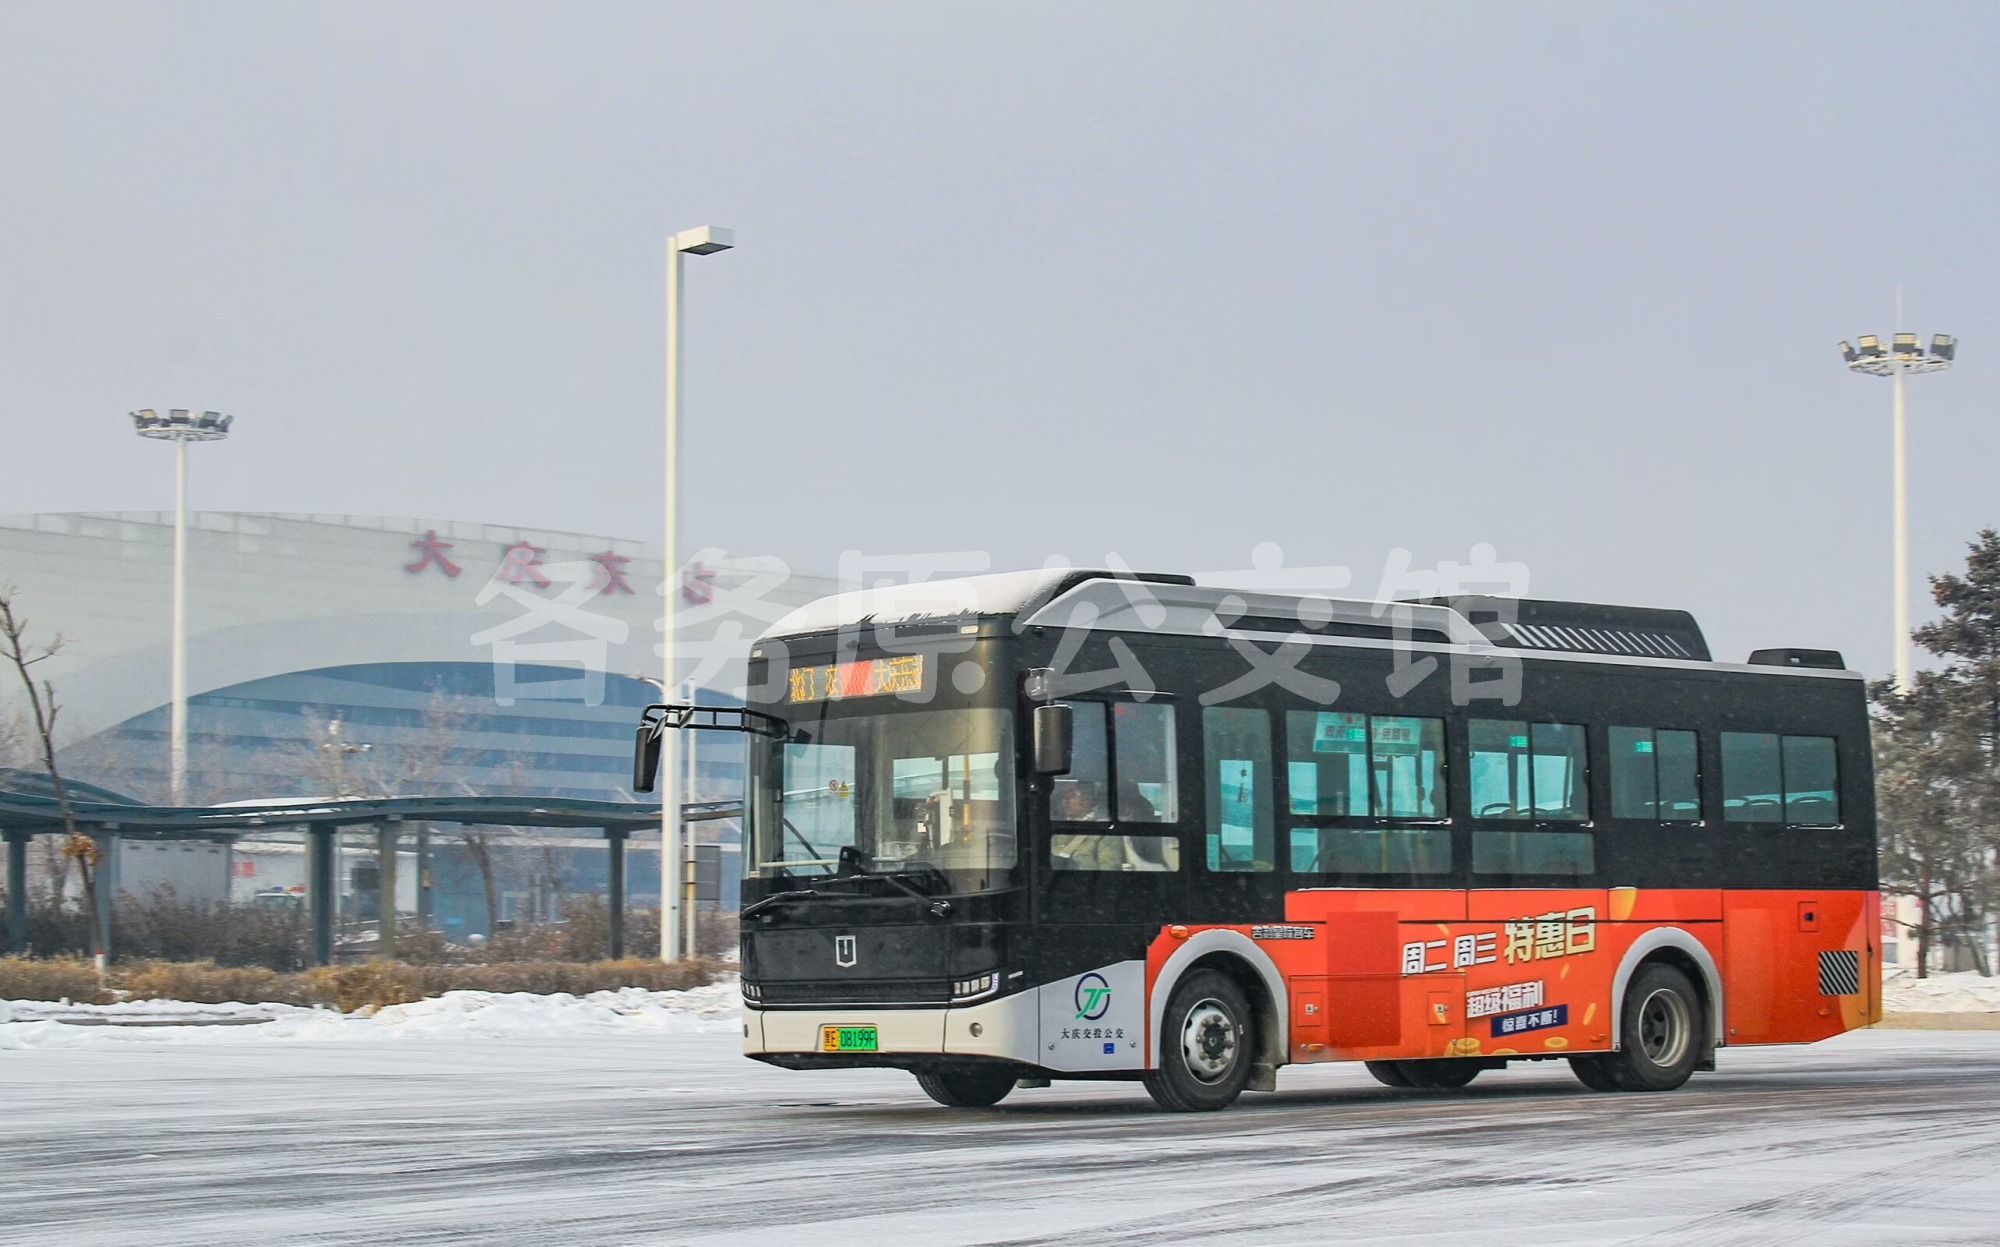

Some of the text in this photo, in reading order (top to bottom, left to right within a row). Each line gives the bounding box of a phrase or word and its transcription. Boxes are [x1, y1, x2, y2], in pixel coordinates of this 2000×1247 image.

[1401, 906, 1597, 977] 周二 周三 特惠日
[1466, 980, 1544, 1019] 超级福利
[1060, 1027, 1125, 1039] 大庆交投公交
